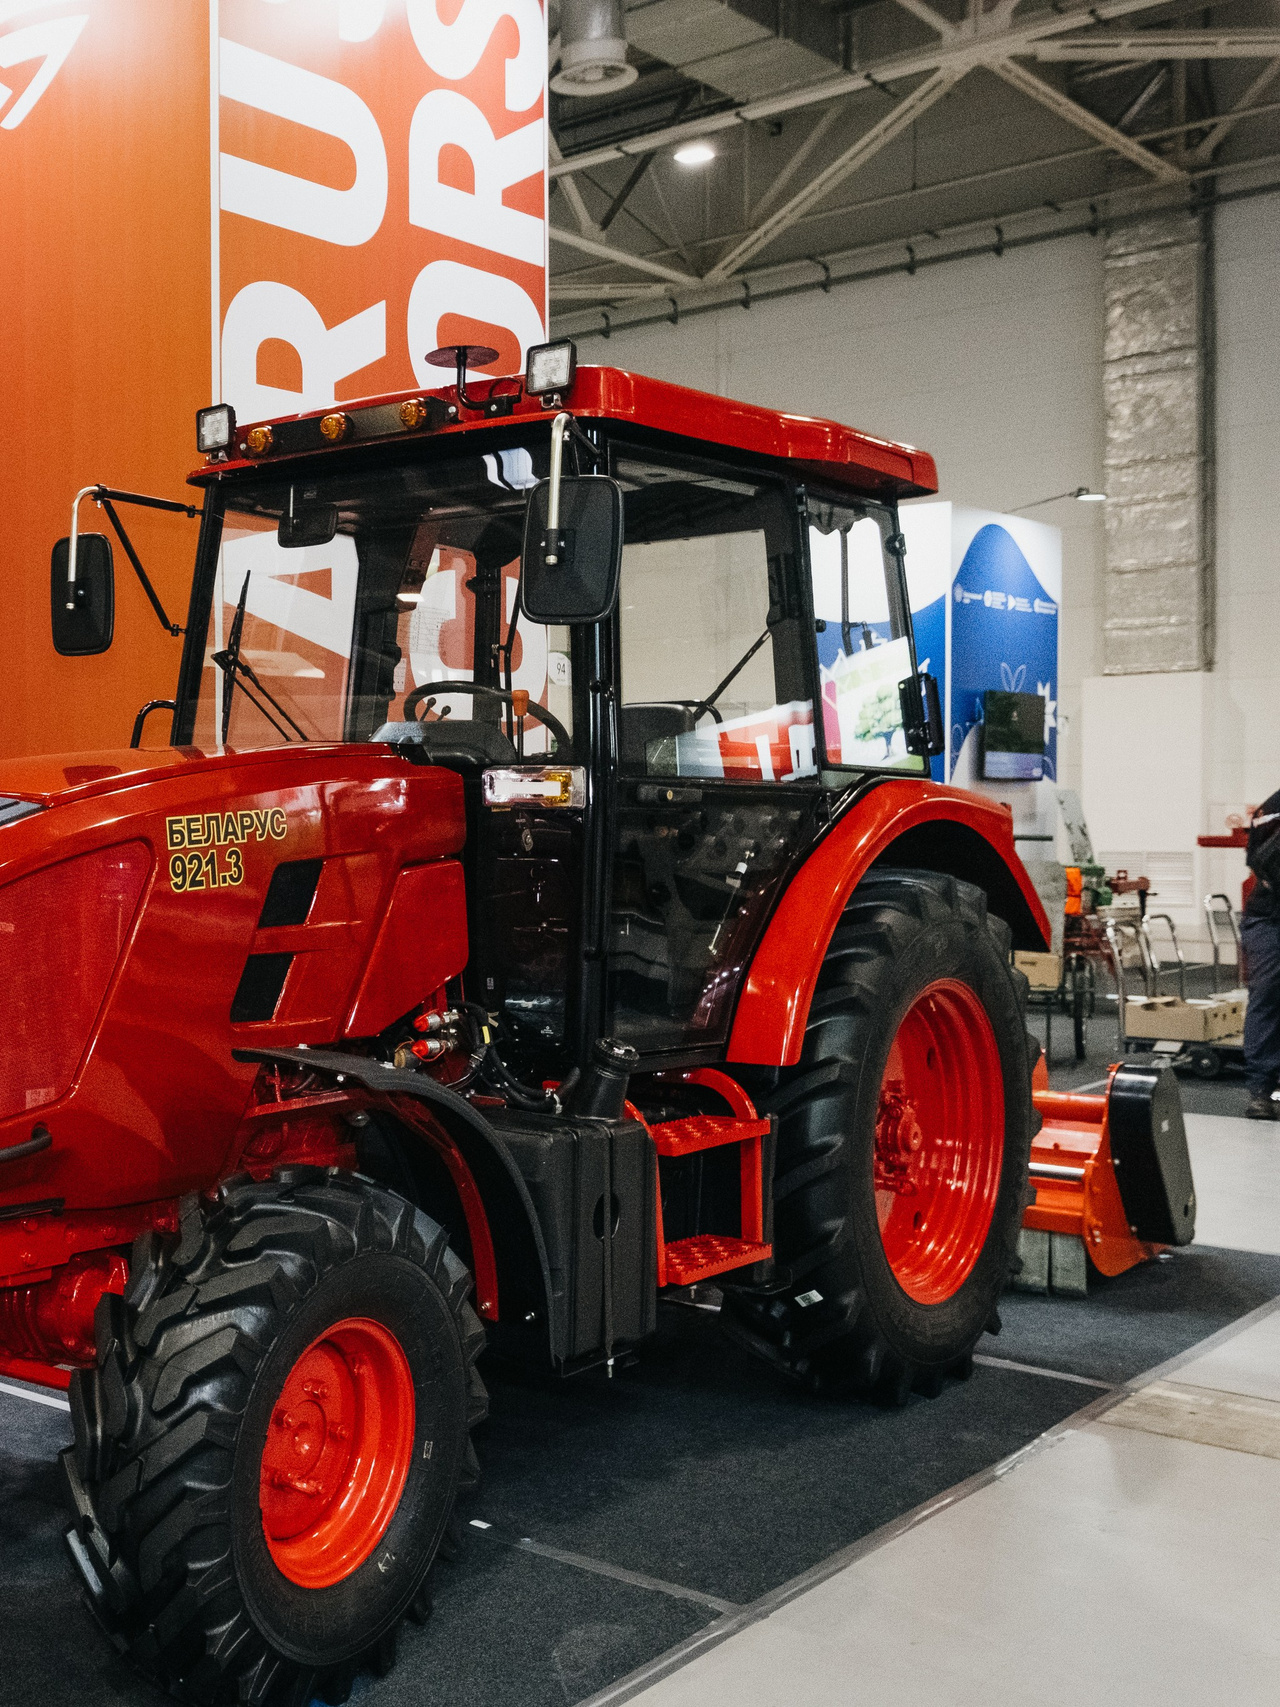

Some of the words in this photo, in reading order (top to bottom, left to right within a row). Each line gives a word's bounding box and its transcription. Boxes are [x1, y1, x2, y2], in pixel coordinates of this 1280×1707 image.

[556, 662, 566, 675] 94
[166, 807, 287, 850] БЕЛАРУС
[170, 848, 244, 893] 921.3
